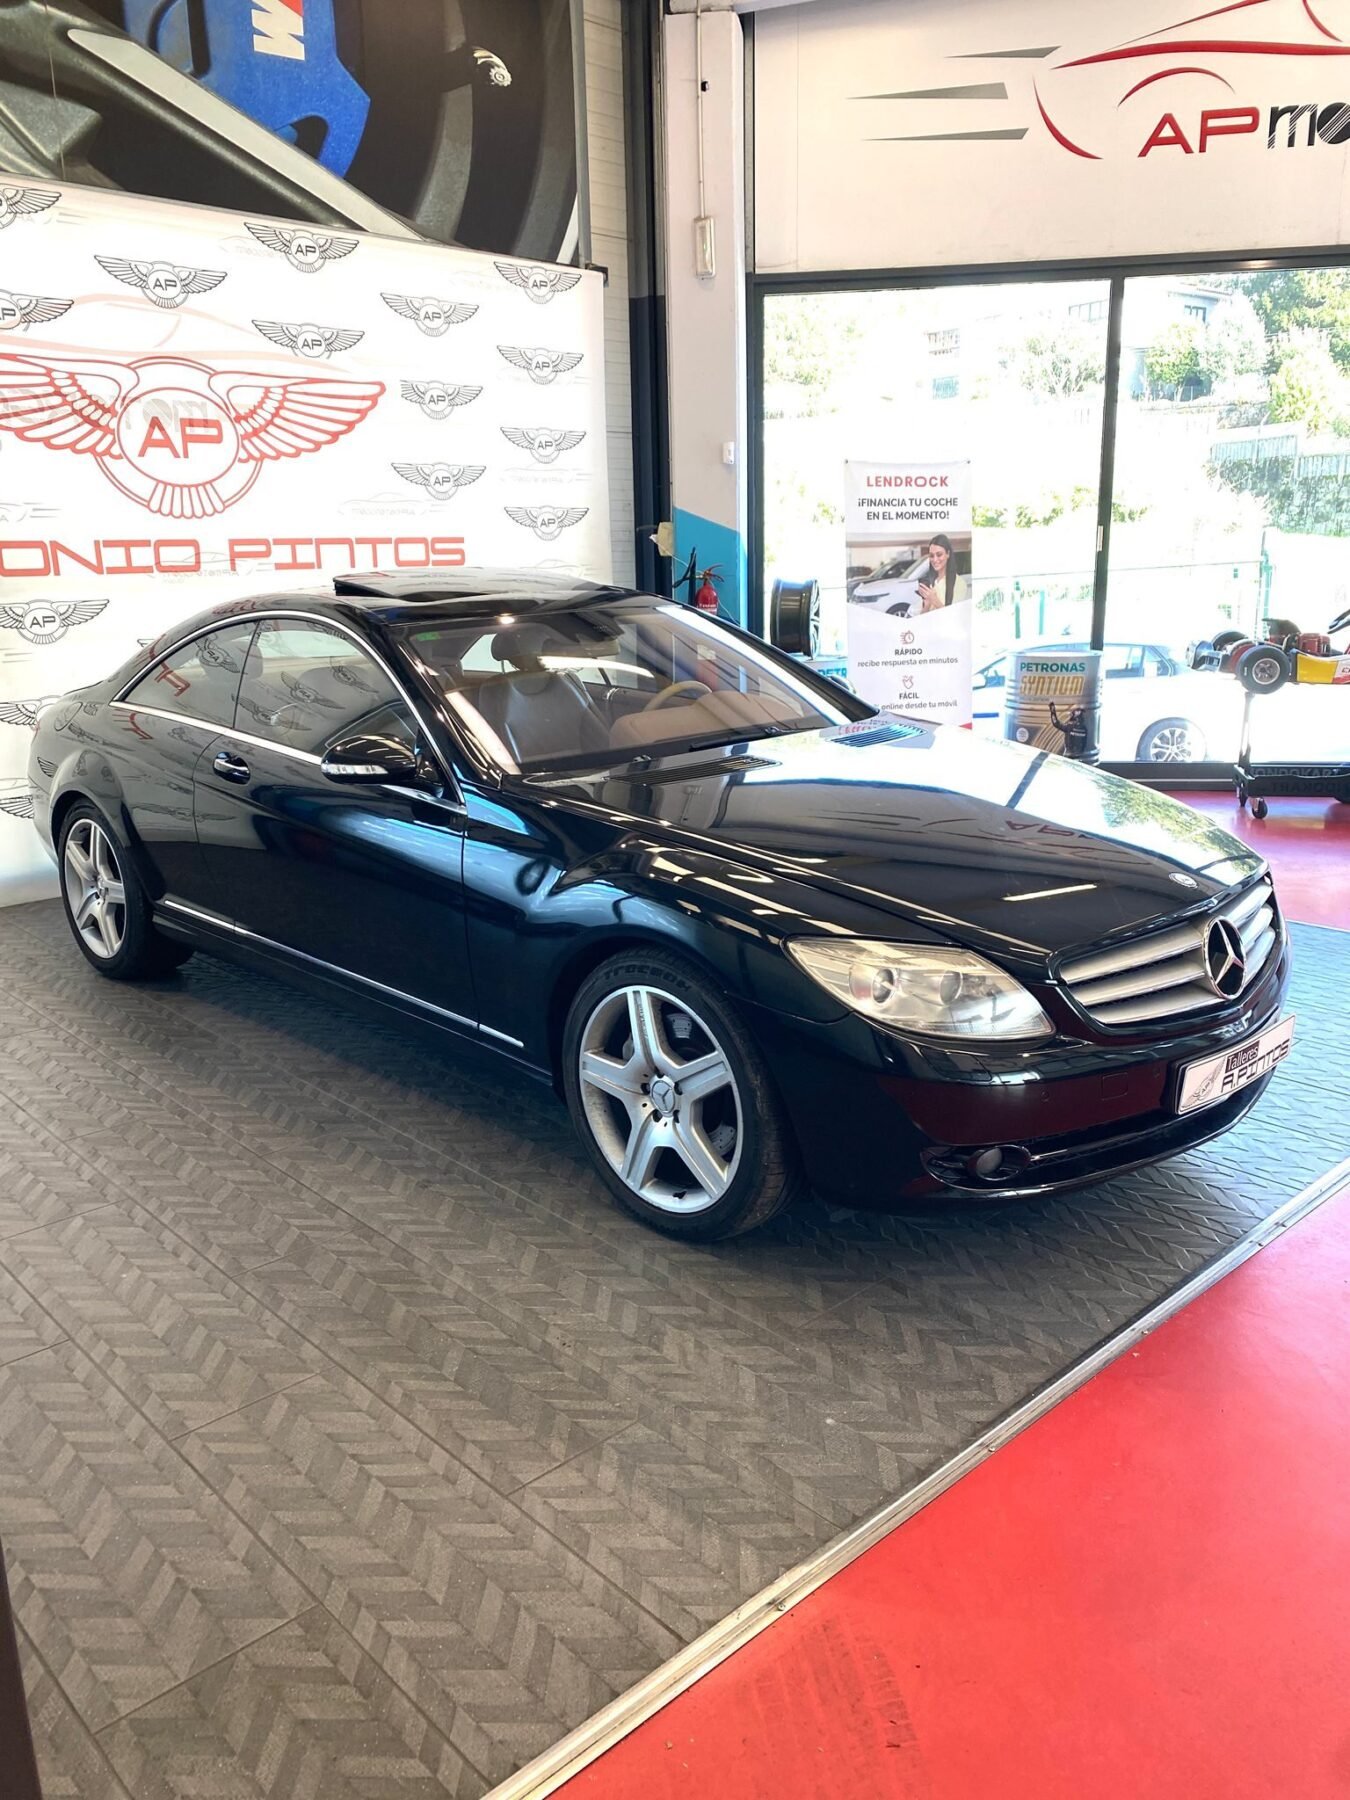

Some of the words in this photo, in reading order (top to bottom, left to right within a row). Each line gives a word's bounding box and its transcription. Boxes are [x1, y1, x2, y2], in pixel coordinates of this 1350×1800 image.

[294, 243, 317, 257] AP
[153, 277, 178, 291] AP
[532, 279, 549, 290] AP
[0, 307, 16, 321] P
[423, 311, 442, 322] AP
[301, 338, 323, 350] AP
[533, 360, 551, 371] AP
[427, 394, 447, 405] AP
[138, 416, 223, 459] AP
[536, 440, 554, 451] AP
[433, 476, 451, 487] AP
[866, 476, 949, 487] LENDROCK
[858, 498, 907, 507] ¡FINANCIA
[908, 498, 922, 507] TU
[924, 498, 958, 507] COCHE
[866, 511, 880, 520] EN
[882, 511, 894, 520] EL
[895, 510, 950, 520] MOMENTO!
[539, 518, 557, 528] AP
[0, 539, 201, 577] ONIO
[228, 537, 466, 571] PINTOS
[29, 615, 57, 629] AP
[894, 647, 923, 656] RÁPIDO
[881, 658, 917, 668] respuesta
[1020, 663, 1085, 672] PETRONAS
[1020, 675, 1085, 697] SYNTIUM
[898, 692, 920, 700] FÁCIL
[937, 699, 958, 707] móvil
[1227, 1046, 1259, 1070] Talleres
[1221, 1038, 1290, 1093] A.PINTOS
